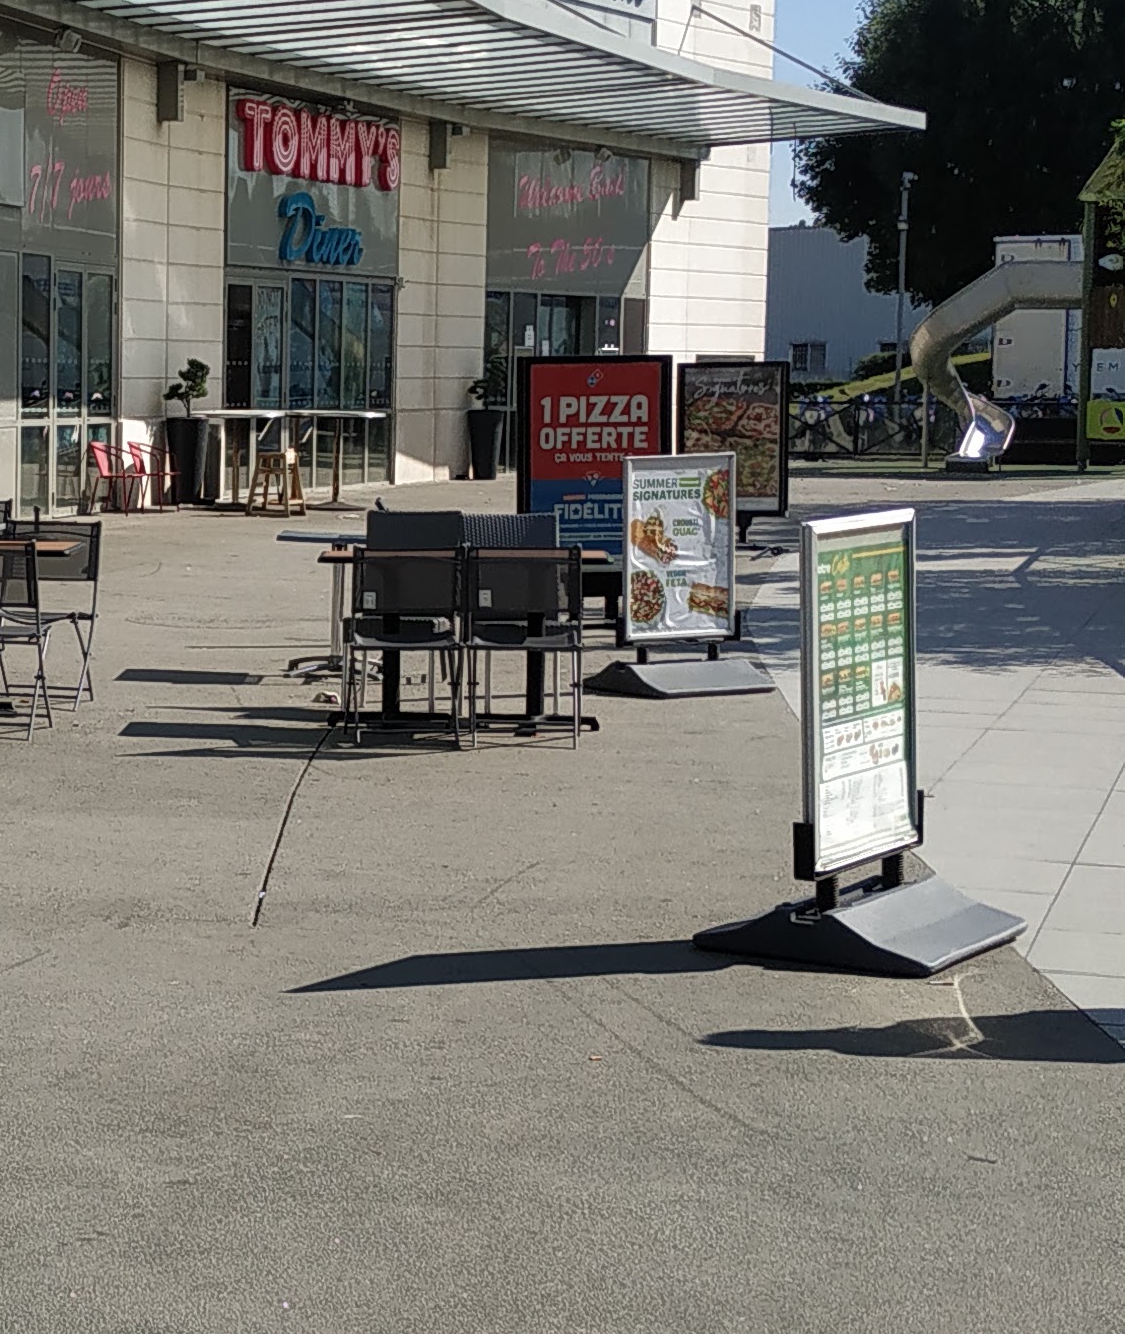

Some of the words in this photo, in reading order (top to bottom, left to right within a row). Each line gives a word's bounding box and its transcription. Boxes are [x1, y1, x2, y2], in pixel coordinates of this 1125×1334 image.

[237, 98, 400, 192] TOMMY'S
[67, 169, 112, 220] jours
[277, 191, 364, 266] Diner
[540, 396, 552, 424] 1
[558, 394, 649, 424] PIZZA
[539, 425, 649, 450] OFFERTE
[569, 452, 593, 463] VOUS
[595, 452, 625, 463] TENTE
[632, 477, 679, 490] SUMMER
[632, 489, 702, 502] SIGNATURES
[554, 501, 624, 520] FIDÉLIT
